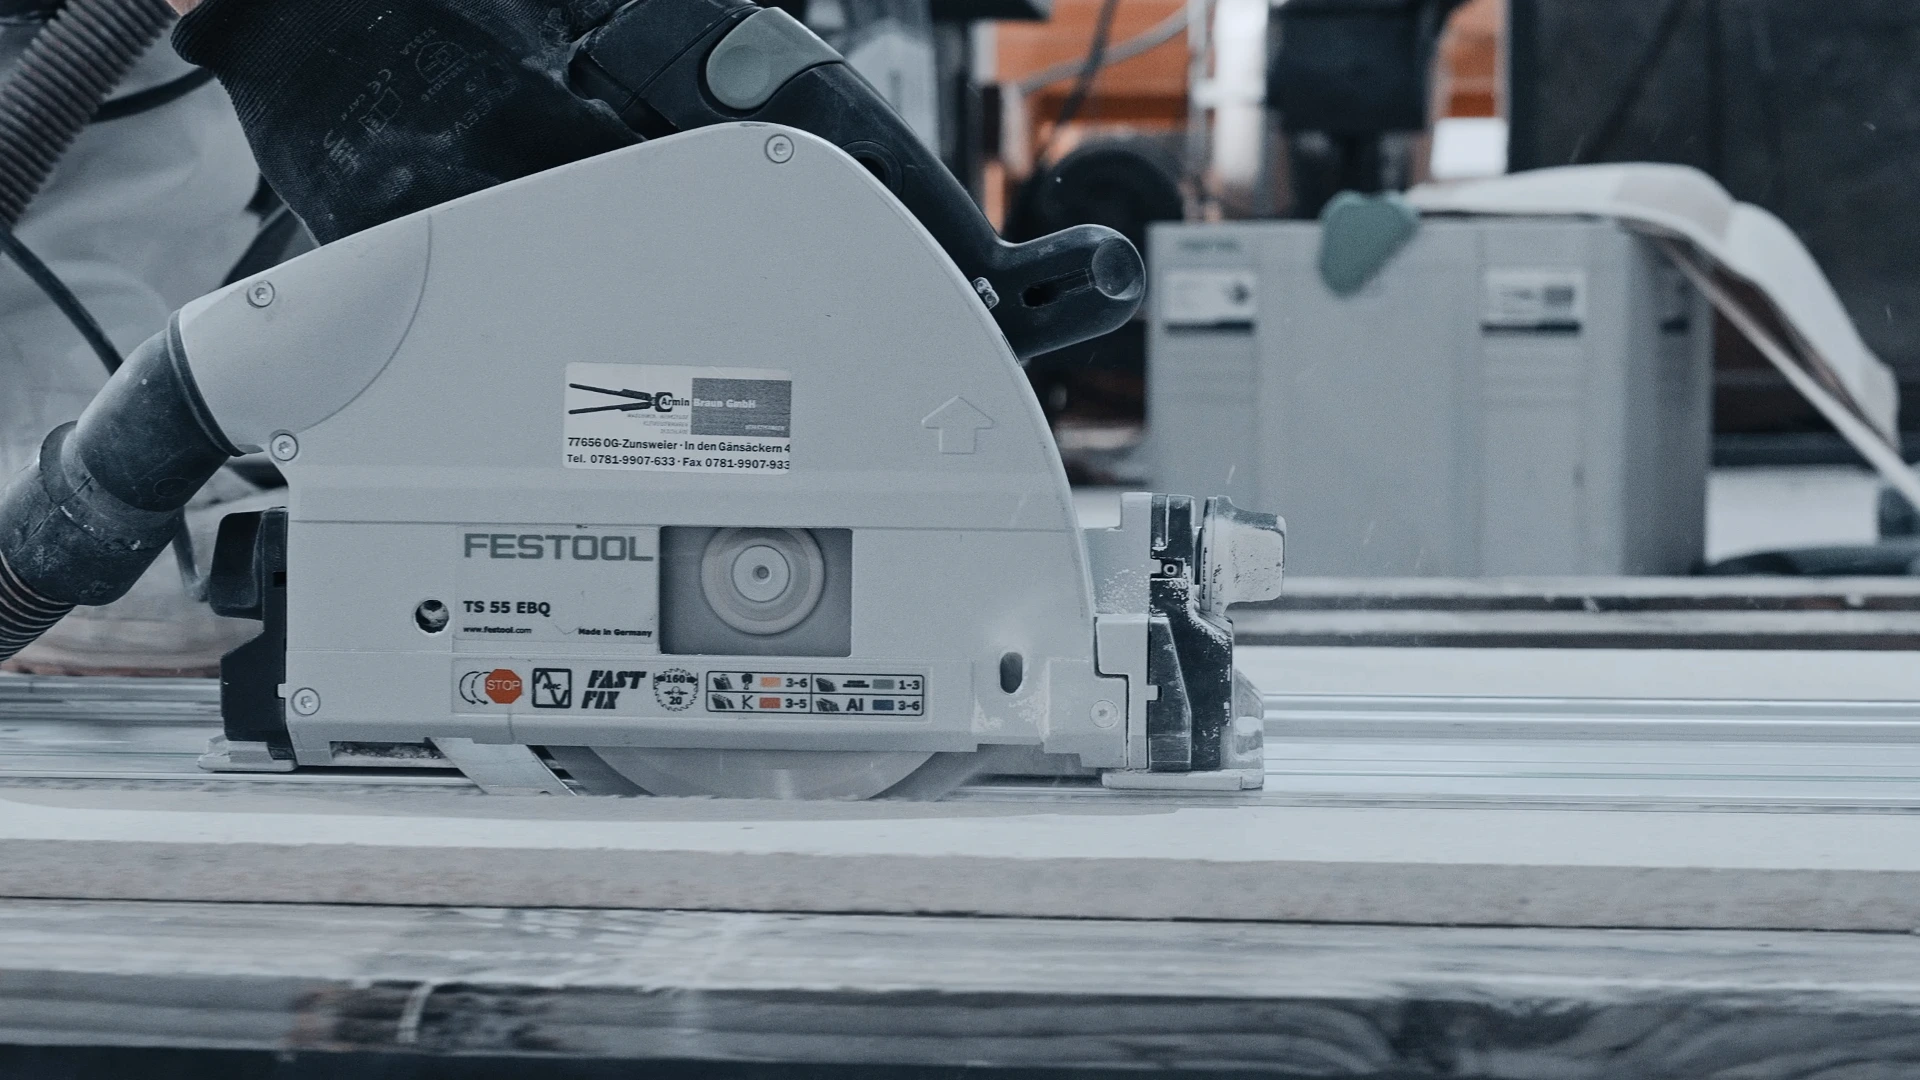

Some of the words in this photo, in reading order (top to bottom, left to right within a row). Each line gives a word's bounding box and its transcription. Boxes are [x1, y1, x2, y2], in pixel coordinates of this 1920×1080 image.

[661, 396, 690, 407] Armin
[693, 398, 723, 408] Braun
[726, 399, 756, 409] GmbH
[568, 437, 601, 447] 77656
[603, 439, 678, 450] OG-Zunsweier
[684, 441, 695, 450] In
[697, 441, 717, 451] den
[718, 441, 783, 453] Gänsäckern
[784, 443, 790, 453] 4
[567, 454, 586, 463] Tel.
[590, 454, 675, 466] 0781-9907-633
[682, 457, 702, 467] Fax
[705, 458, 790, 469] 0781-9907-933
[464, 533, 654, 561] FESTOOL
[463, 600, 485, 613] TS
[489, 601, 511, 614] 55
[516, 602, 551, 617] EBQ
[463, 626, 532, 634] www.festool.com
[578, 628, 601, 636] Made
[603, 628, 611, 636] in
[613, 629, 653, 638] Germany
[587, 670, 647, 689] FAST
[665, 674, 686, 684] 160
[785, 678, 808, 688] 3-6
[486, 680, 521, 691] STOP
[898, 680, 920, 690] 1-3
[581, 690, 620, 709] FIX
[669, 696, 683, 705] 20
[741, 694, 754, 710] K
[785, 698, 808, 709] 3-5
[898, 701, 920, 711] 3-6
